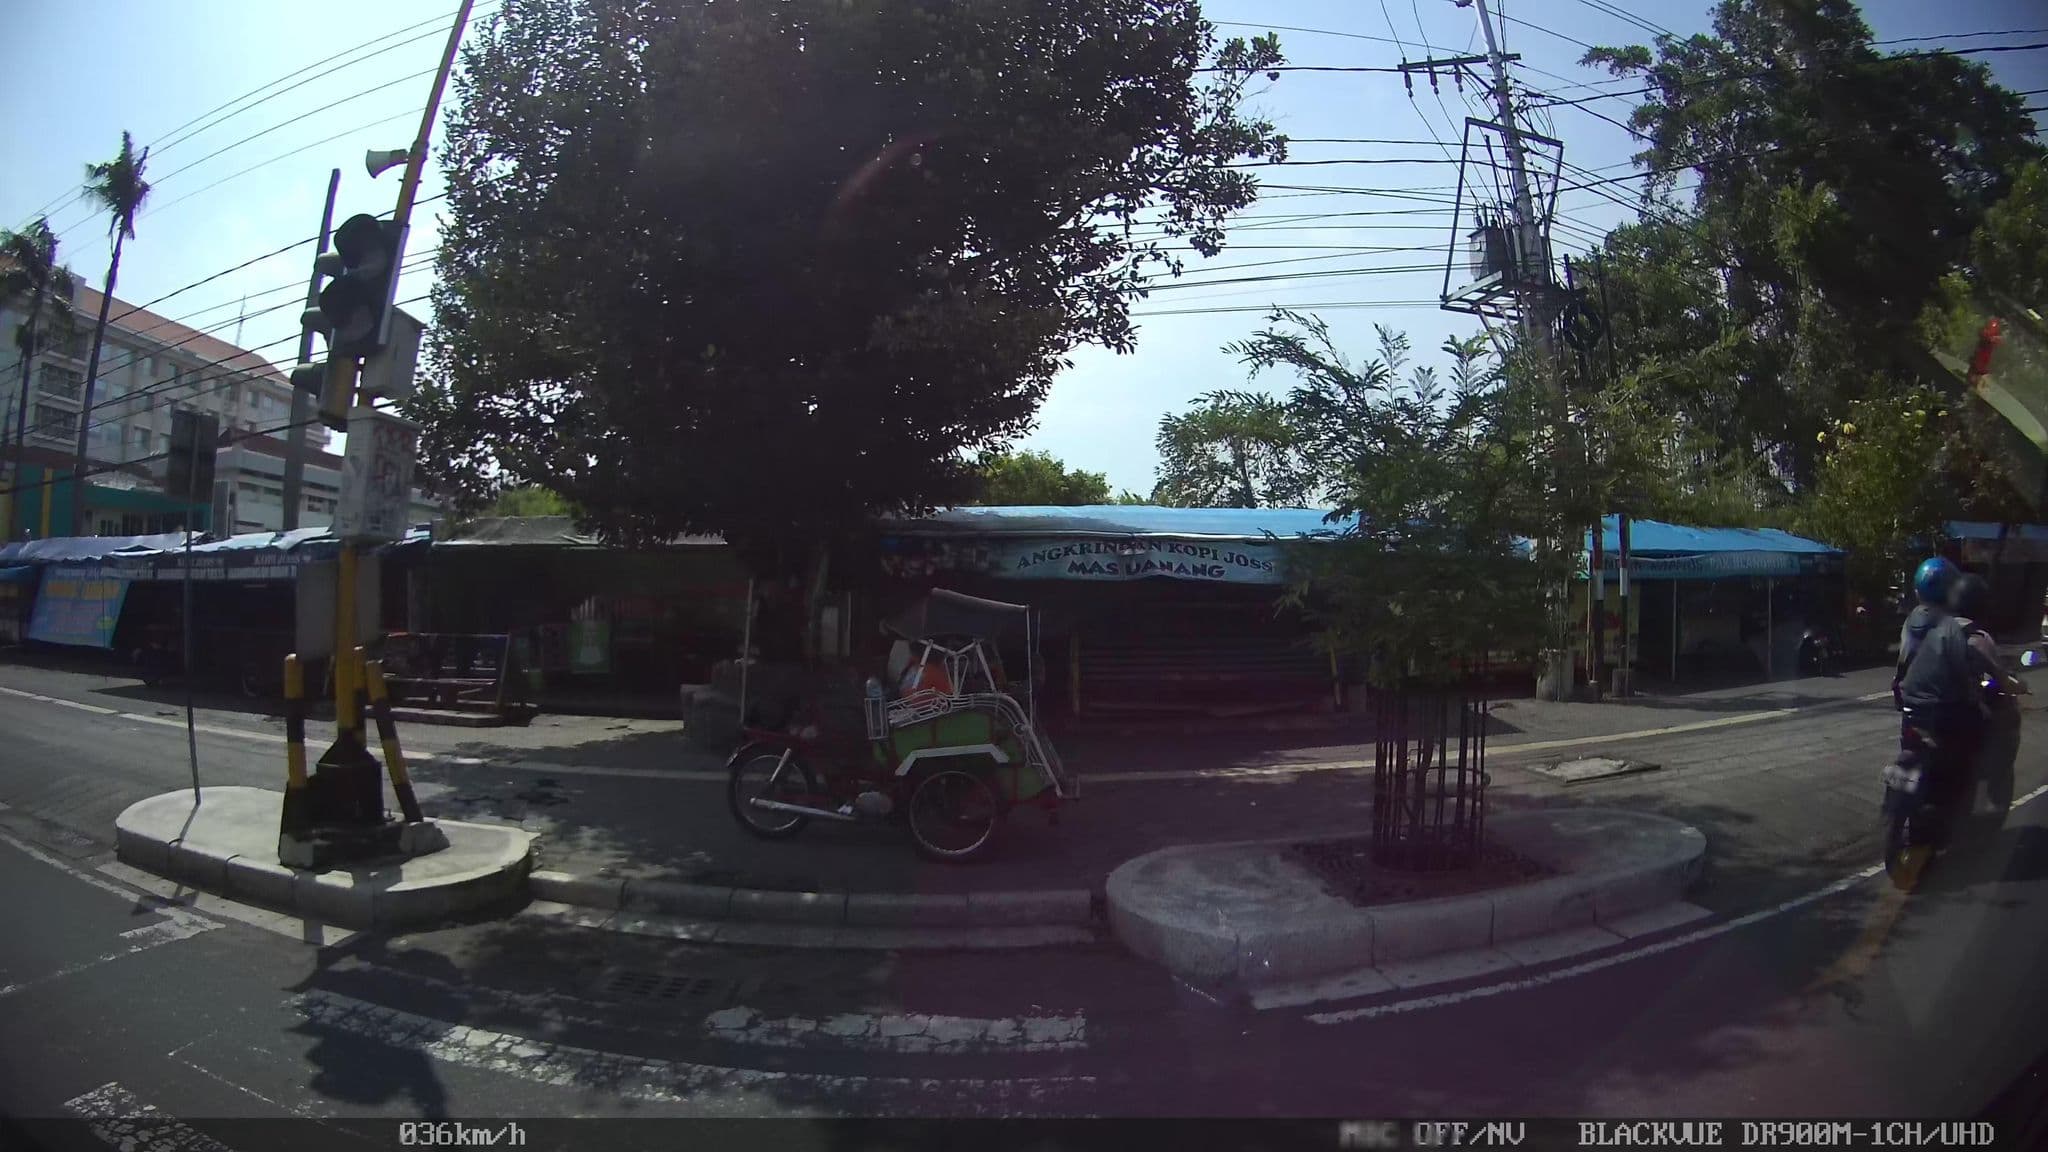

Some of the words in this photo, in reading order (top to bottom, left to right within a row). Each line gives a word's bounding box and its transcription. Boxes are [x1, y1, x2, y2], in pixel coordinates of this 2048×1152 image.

[1066, 559, 1119, 577] MAS
[1167, 542, 1219, 562] KOPI
[1223, 552, 1273, 574] JOSS
